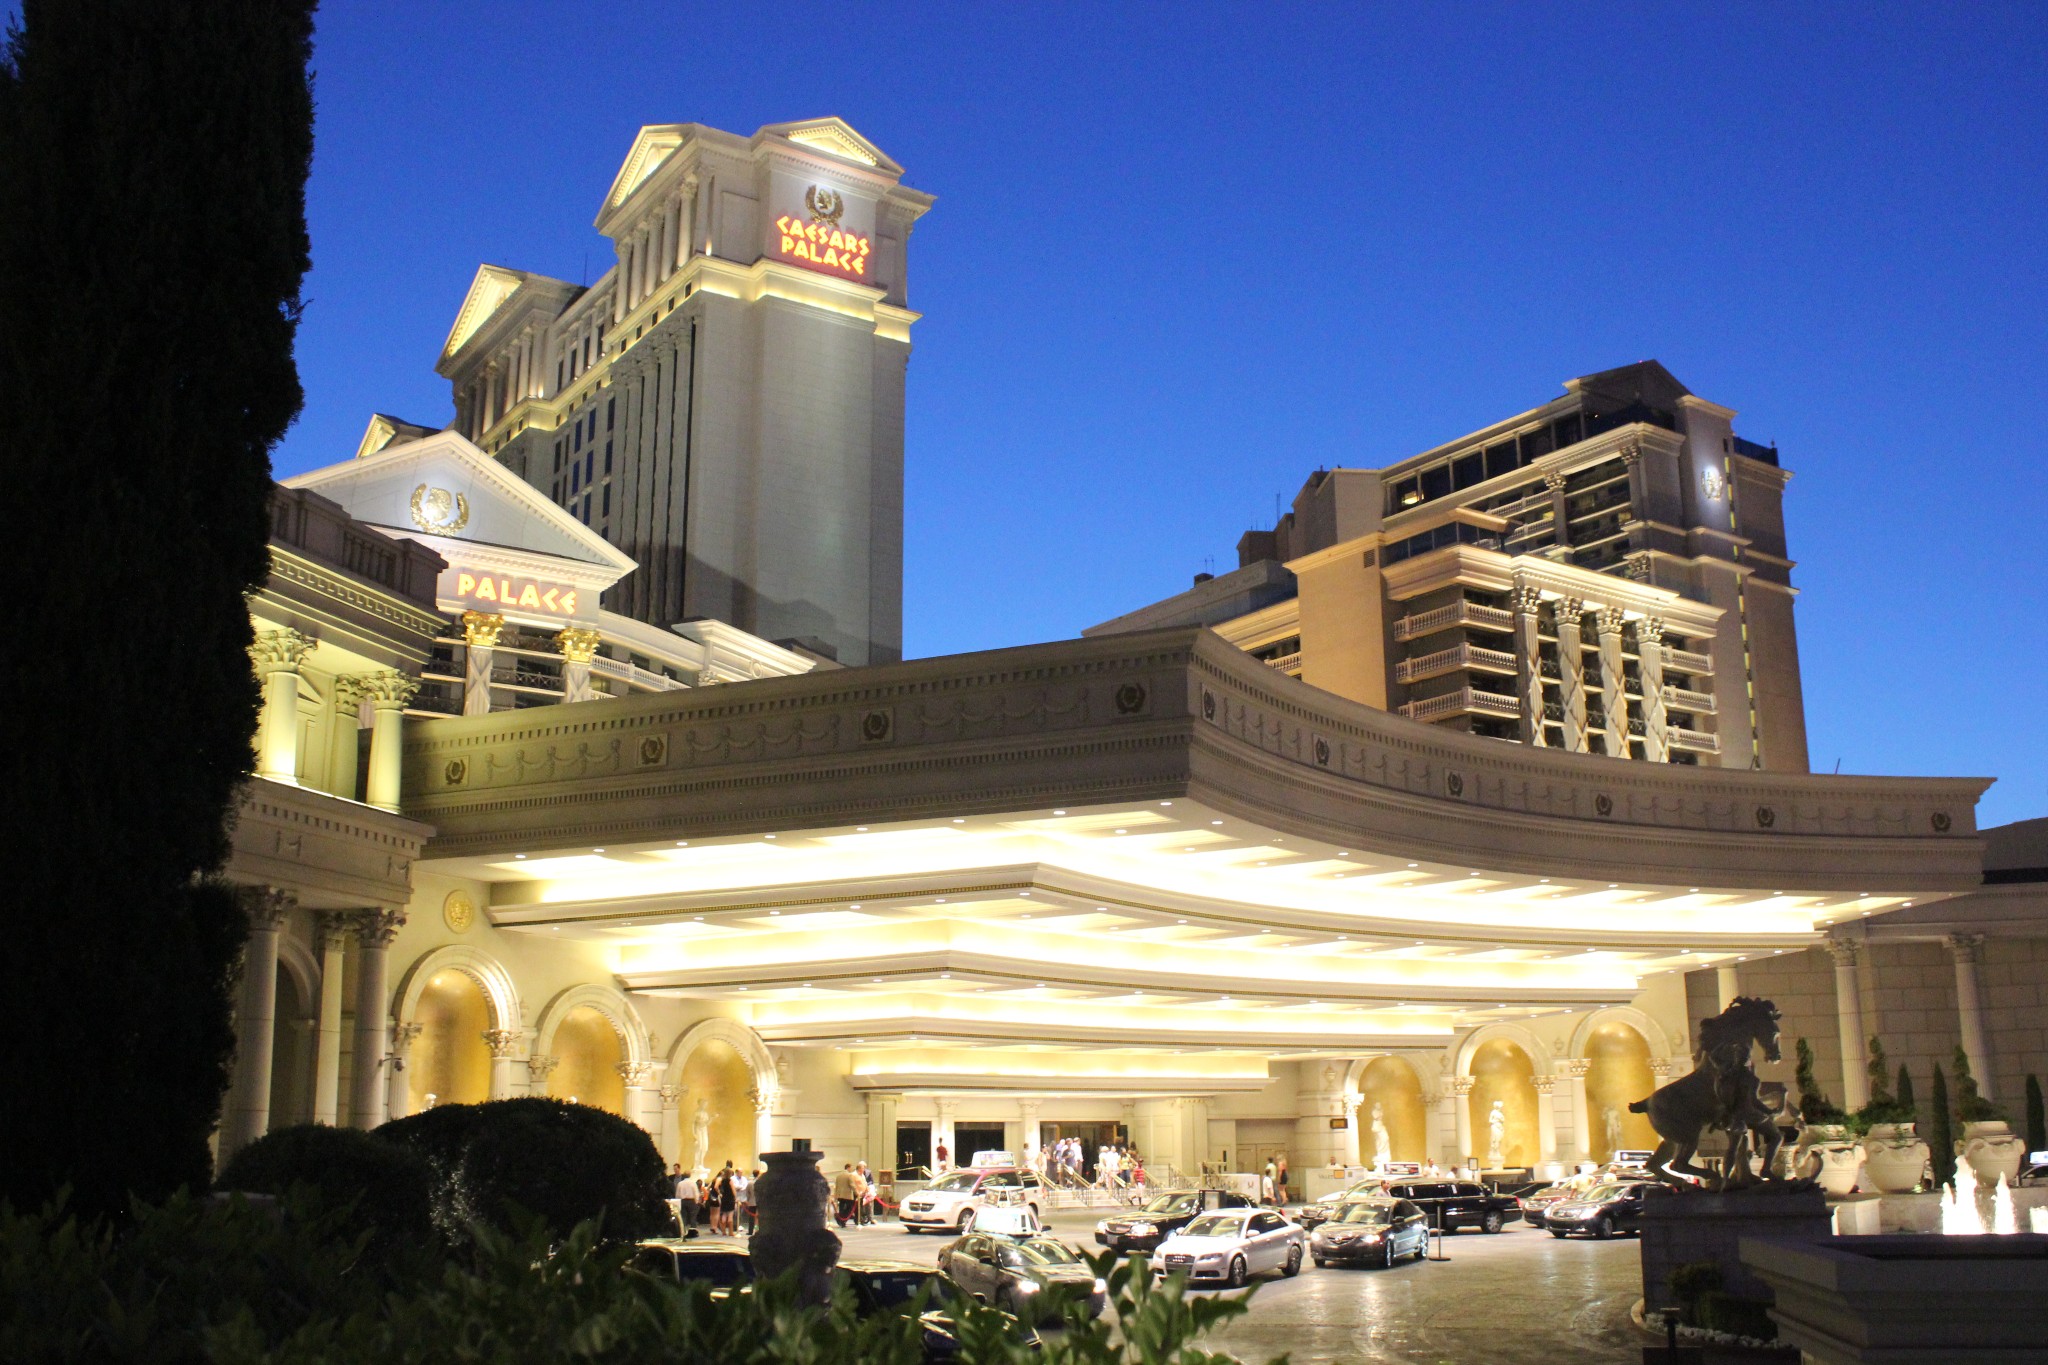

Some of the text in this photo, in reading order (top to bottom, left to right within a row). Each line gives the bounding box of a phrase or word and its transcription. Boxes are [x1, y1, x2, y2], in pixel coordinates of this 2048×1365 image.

[776, 216, 870, 257] CAESARS
[781, 236, 865, 275] PALACE
[457, 573, 577, 615] PALACE
